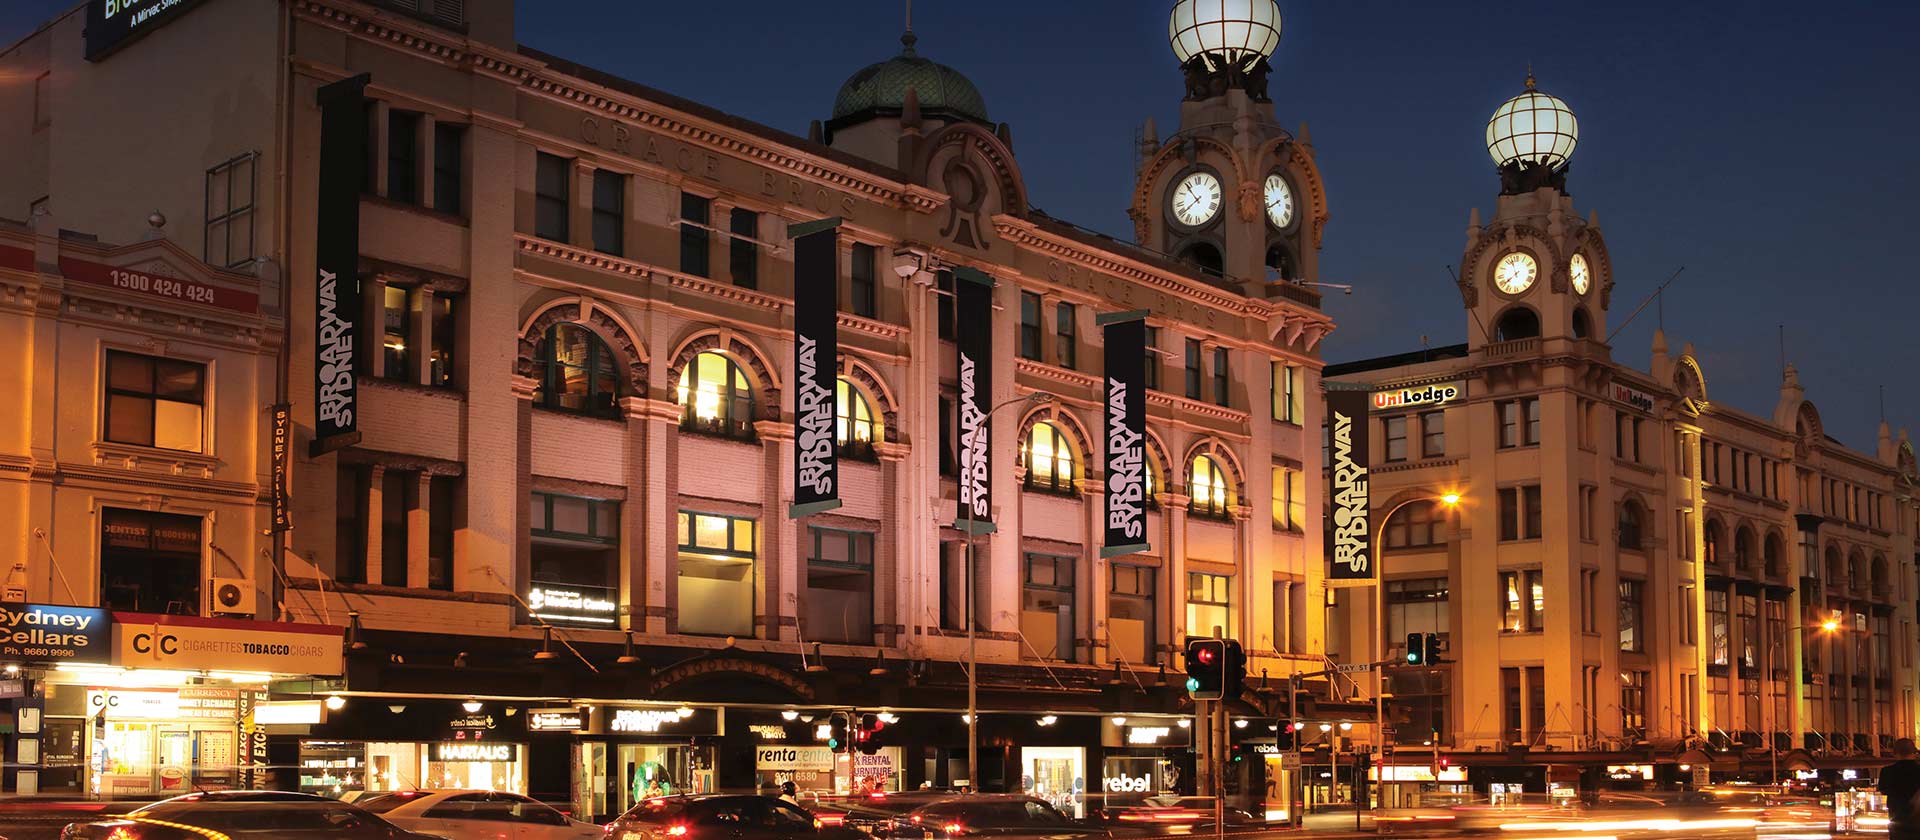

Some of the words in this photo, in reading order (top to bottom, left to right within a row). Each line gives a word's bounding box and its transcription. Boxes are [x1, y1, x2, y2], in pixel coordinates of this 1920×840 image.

[130, 15, 137, 28] A
[580, 117, 721, 182] GRACE
[762, 170, 856, 220] BROS
[110, 270, 149, 291] 1300
[154, 279, 182, 298] 424
[186, 285, 214, 304] 424
[1047, 260, 1132, 304] GRACE
[320, 268, 336, 421] BROADWAY
[335, 318, 352, 428] SYDNEY
[799, 334, 816, 488] BROADWAY
[1375, 386, 1456, 407] UniLodge
[275, 411, 286, 460] SYDNEY
[814, 383, 832, 494] SYDNEY
[1110, 376, 1126, 530] BROADWAY
[1124, 426, 1142, 538] SYDNEY
[1334, 410, 1352, 564] BROADWAY
[1350, 462, 1368, 573] SYDNEY
[0, 627, 88, 646] Cellars
[4, 647, 20, 655] Ph.
[24, 648, 48, 656] 9660
[184, 688, 230, 696] CURRENCY
[440, 745, 510, 760] HAIRTALKS
[758, 748, 832, 762] rentacentre
[862, 756, 892, 765] RENTAL
[239, 758, 247, 790] ONEY
[796, 772, 817, 781] 6580
[854, 767, 892, 776] URNITURE
[1102, 773, 1150, 792] rebel
